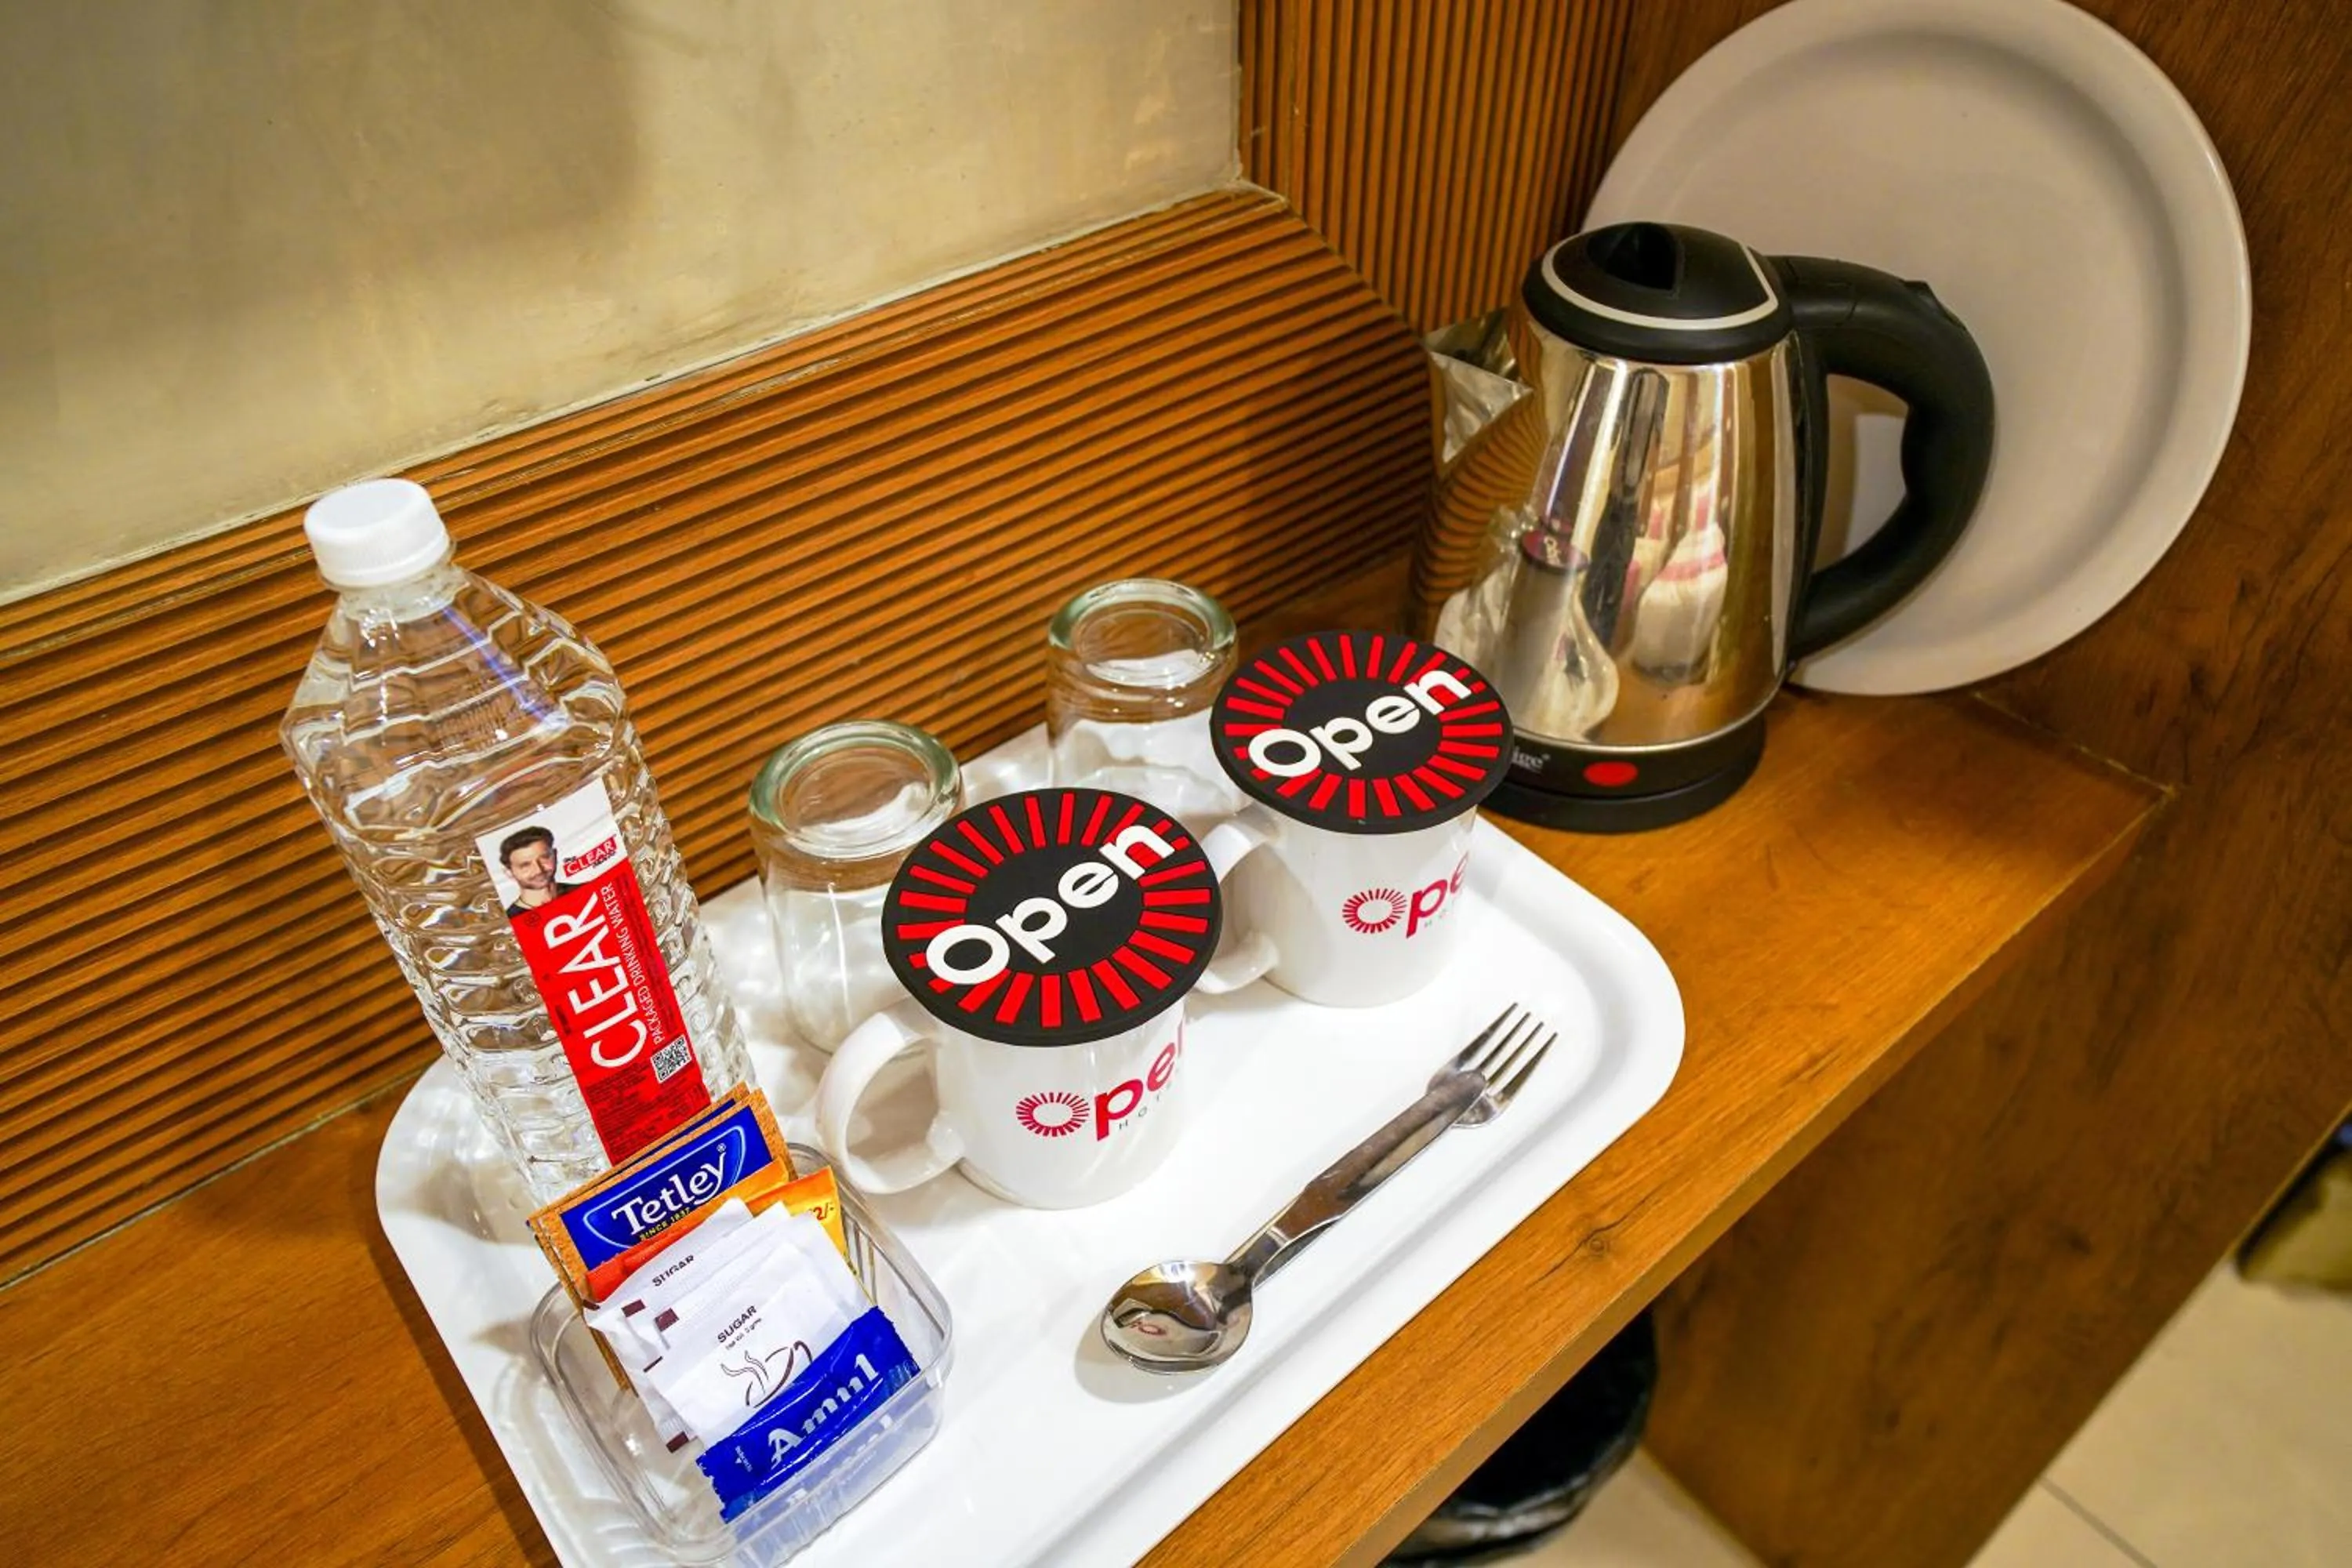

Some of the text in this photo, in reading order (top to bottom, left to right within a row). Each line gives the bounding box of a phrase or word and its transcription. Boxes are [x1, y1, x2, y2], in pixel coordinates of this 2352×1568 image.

[1247, 670, 1472, 777] Open
[566, 840, 615, 874] CLEAR
[600, 882, 622, 929] WATER
[926, 825, 1175, 985] Open
[1341, 850, 1469, 938] Ope
[543, 892, 648, 1068] CLEAR
[615, 927, 646, 987] DRINKING
[637, 985, 666, 1045] PACKAGED
[612, 1152, 727, 1236] Tetley
[717, 1305, 757, 1343] SUGAR
